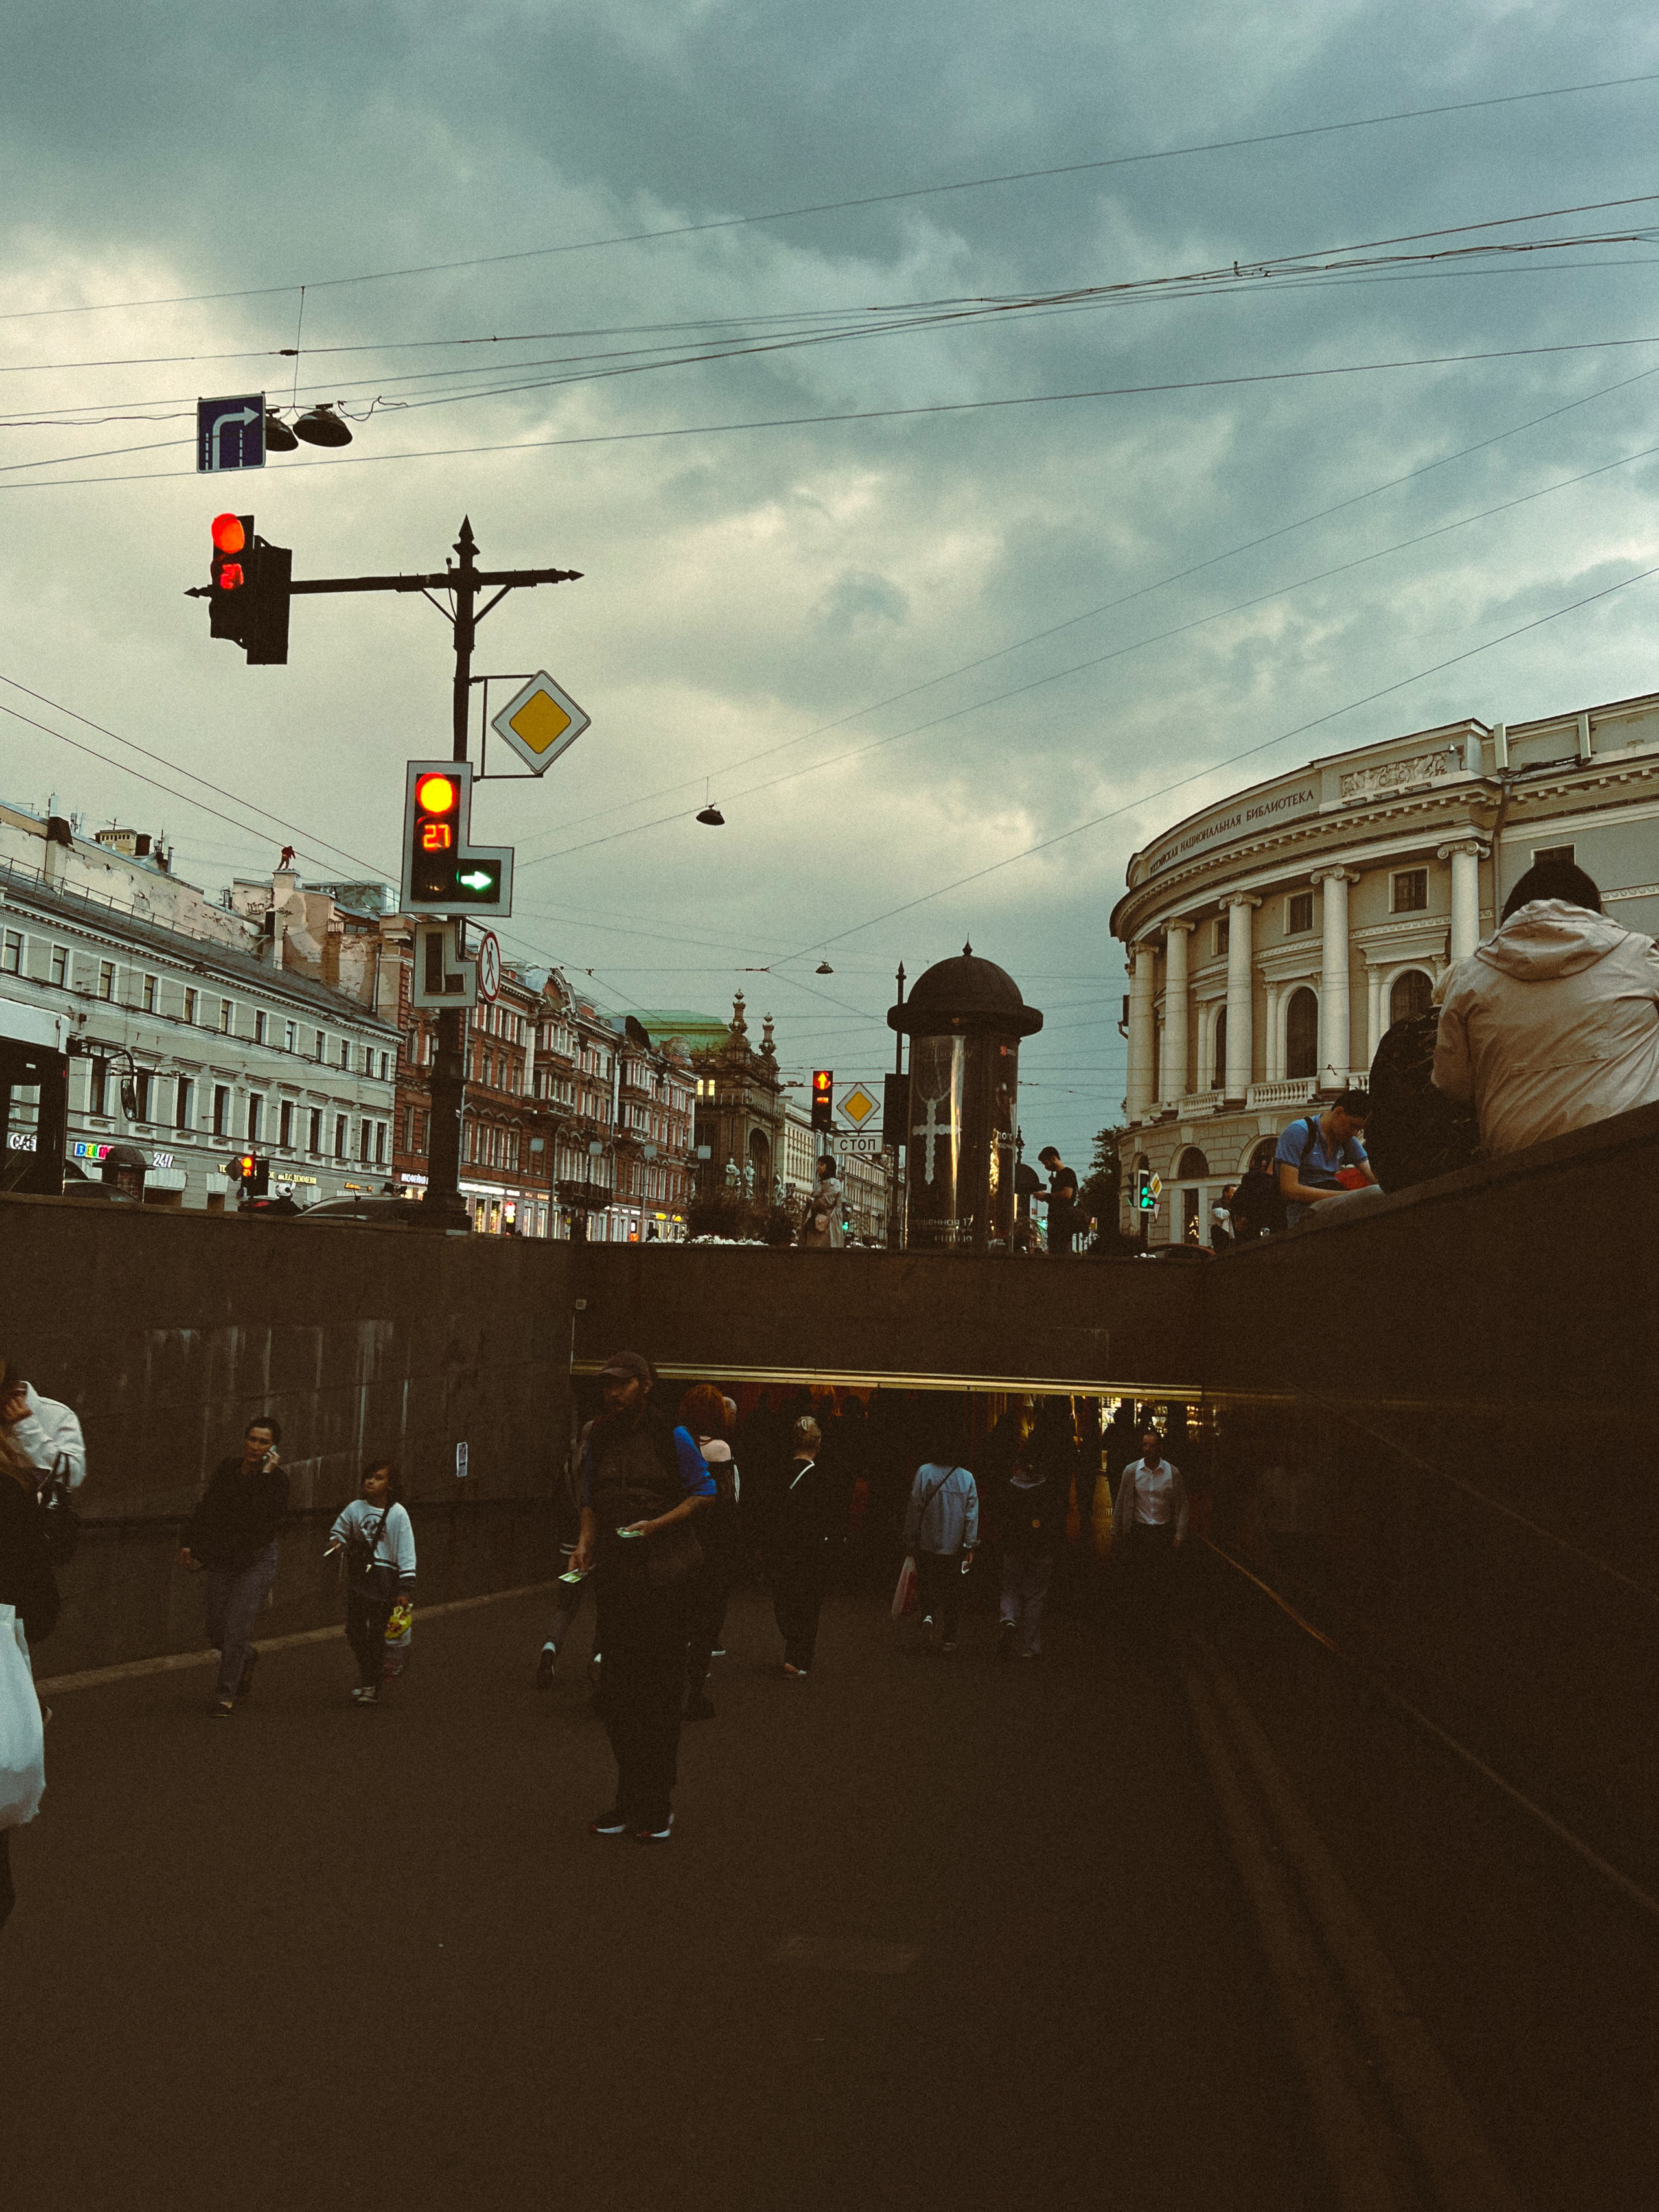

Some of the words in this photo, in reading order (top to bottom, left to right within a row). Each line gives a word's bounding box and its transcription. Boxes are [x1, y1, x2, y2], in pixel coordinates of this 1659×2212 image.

[1180, 814, 1241, 853] НАЦИОНАЛЬНАЯ
[1246, 789, 1314, 822] БИБЛИОТЕКА
[423, 824, 450, 850] 27
[840, 1139, 876, 1151] СТОП
